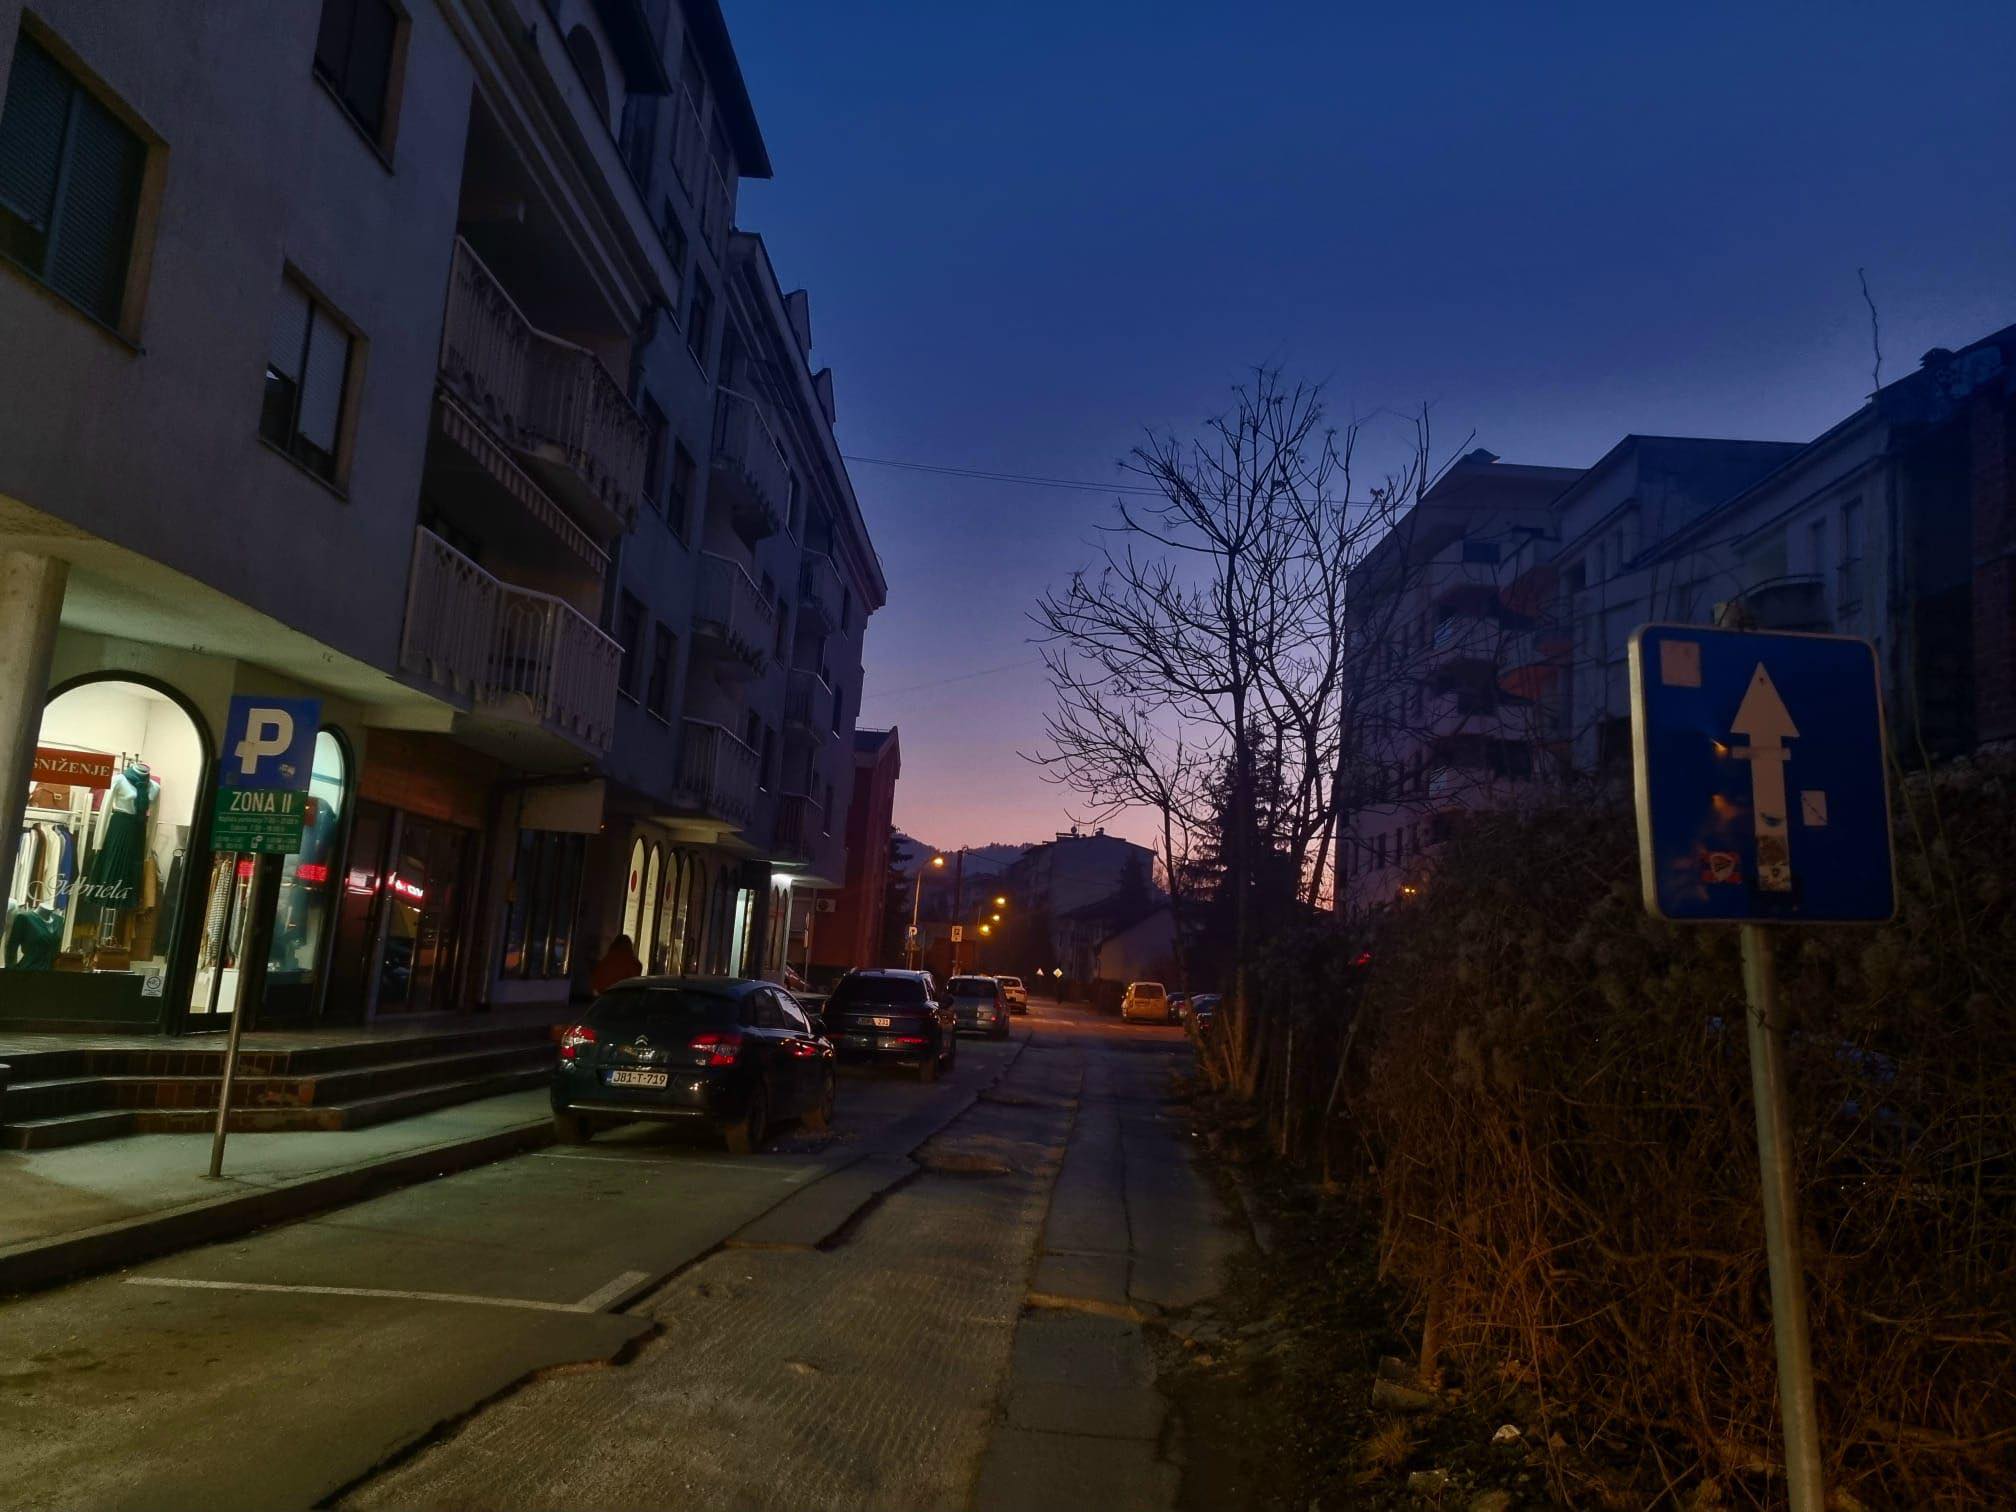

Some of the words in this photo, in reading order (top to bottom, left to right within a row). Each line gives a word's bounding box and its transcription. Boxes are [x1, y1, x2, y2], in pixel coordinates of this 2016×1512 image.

[234, 708, 294, 774] P
[230, 791, 275, 813] ZONA
[282, 793, 293, 813] II
[28, 873, 133, 901] Gabriela
